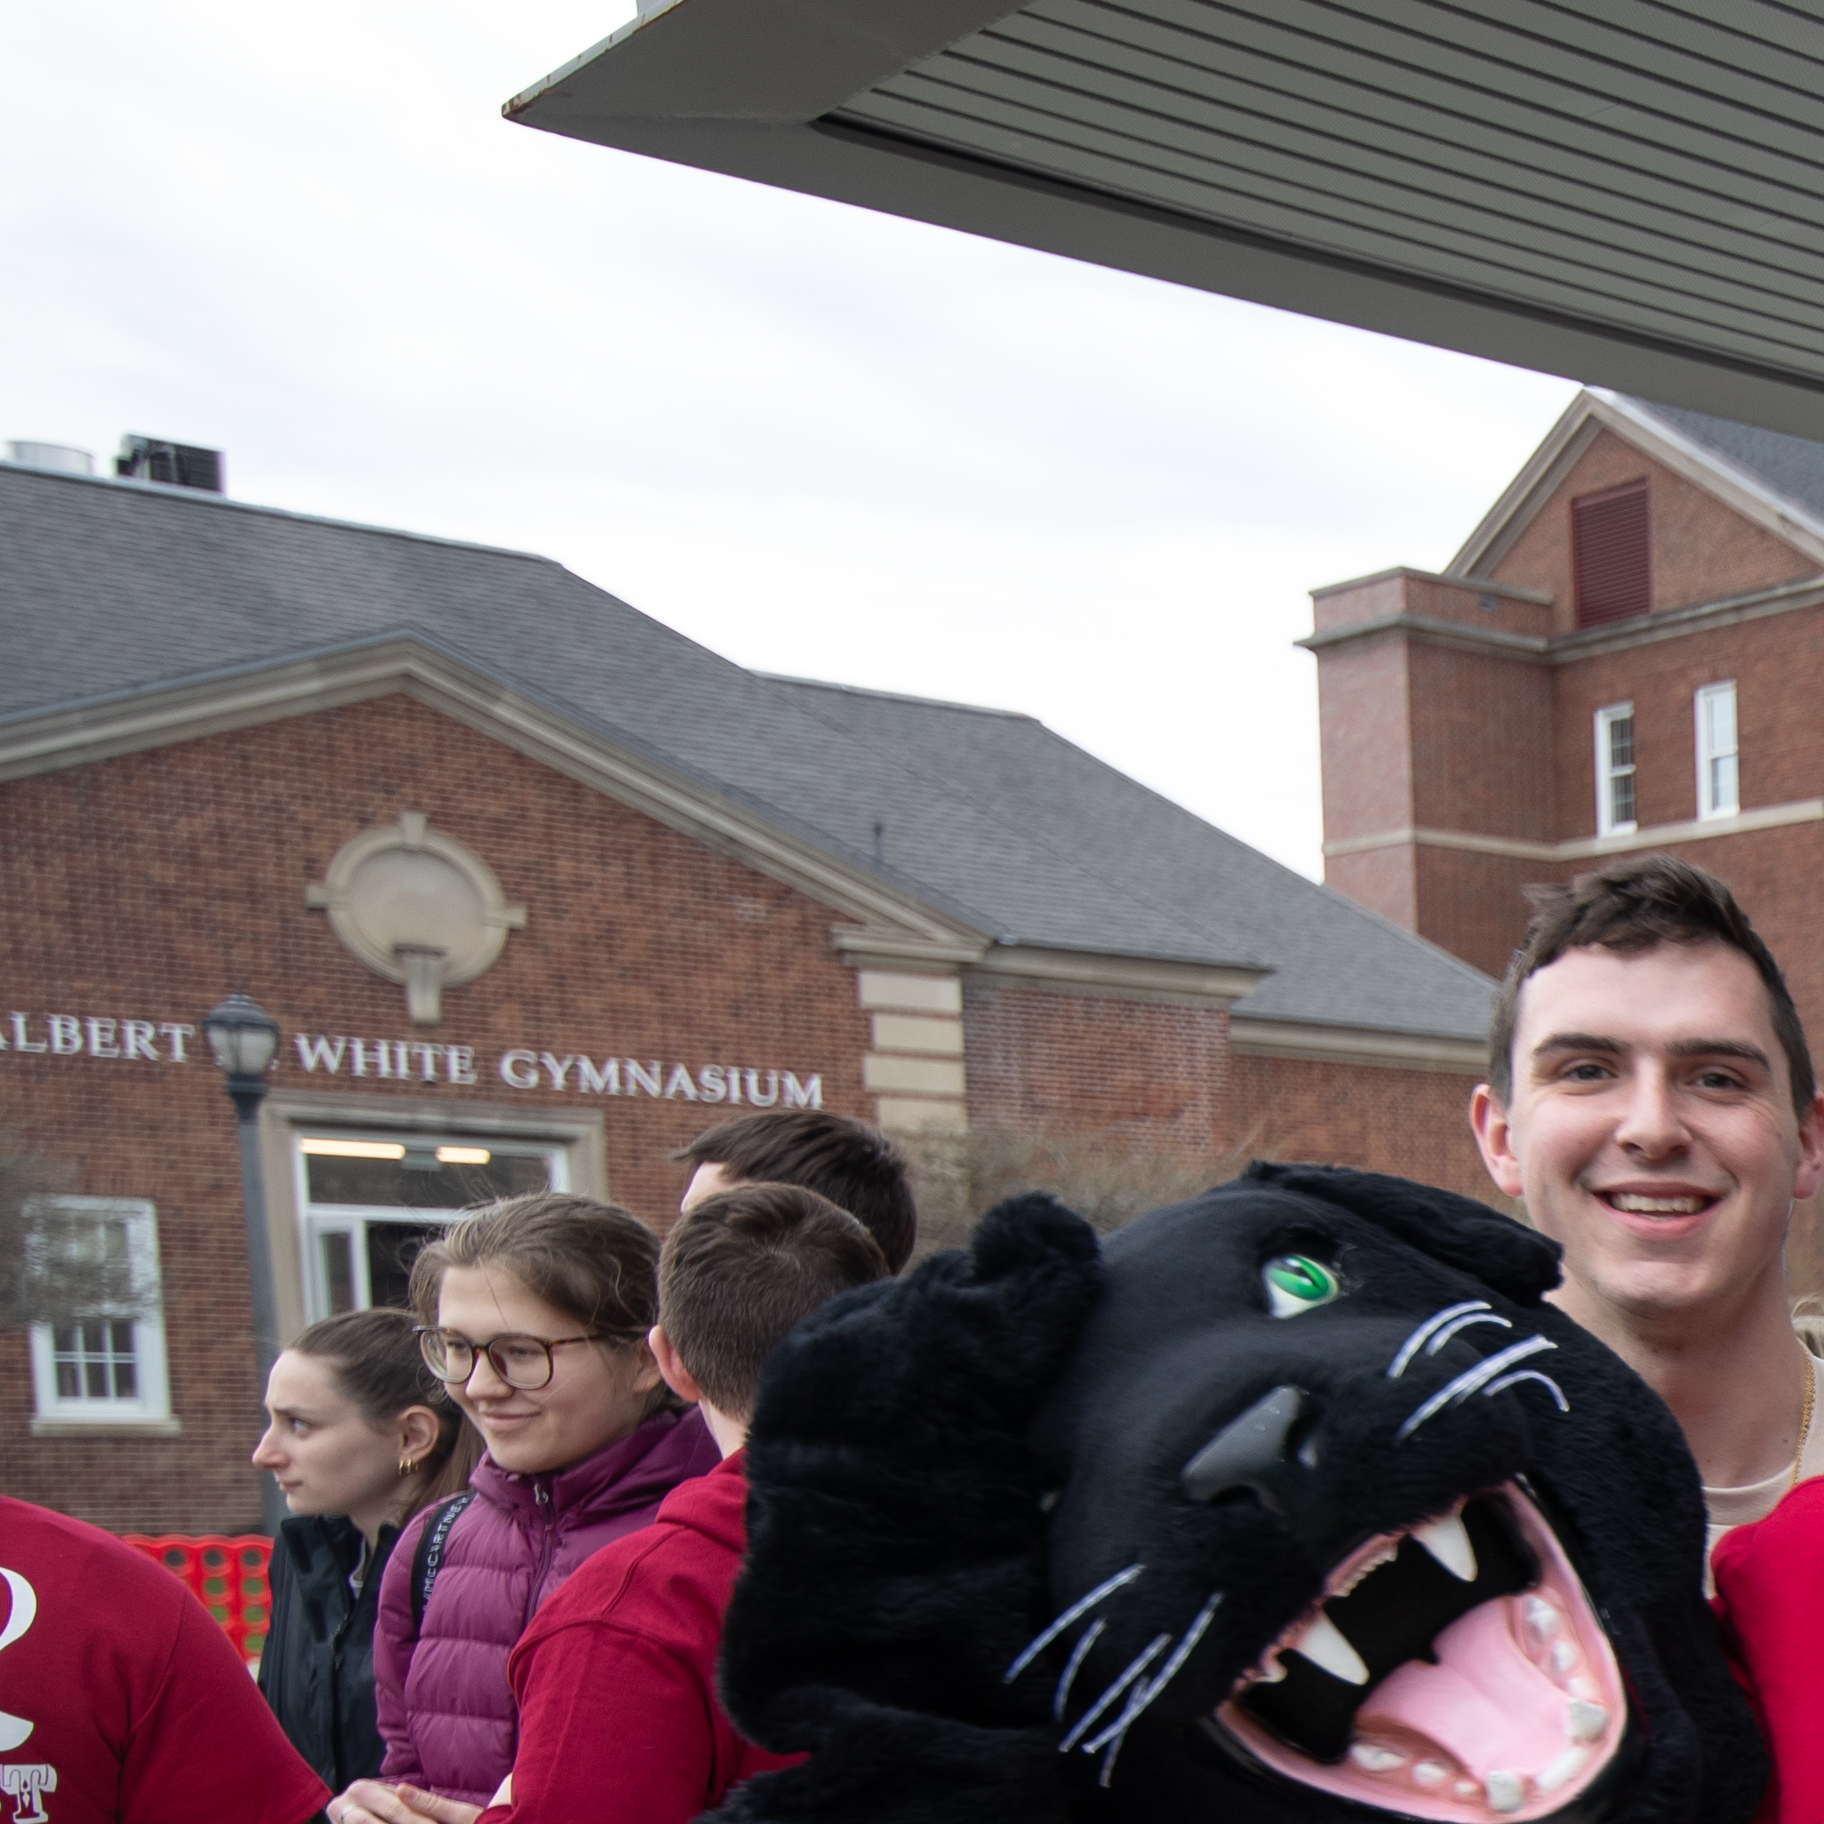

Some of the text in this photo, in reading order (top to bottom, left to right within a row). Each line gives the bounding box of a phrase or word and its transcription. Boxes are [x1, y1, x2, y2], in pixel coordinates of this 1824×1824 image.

[0, 1010, 196, 1063] LBERT
[294, 1032, 478, 1085] WHITE
[500, 1049, 824, 1111] GYMNASIUM
